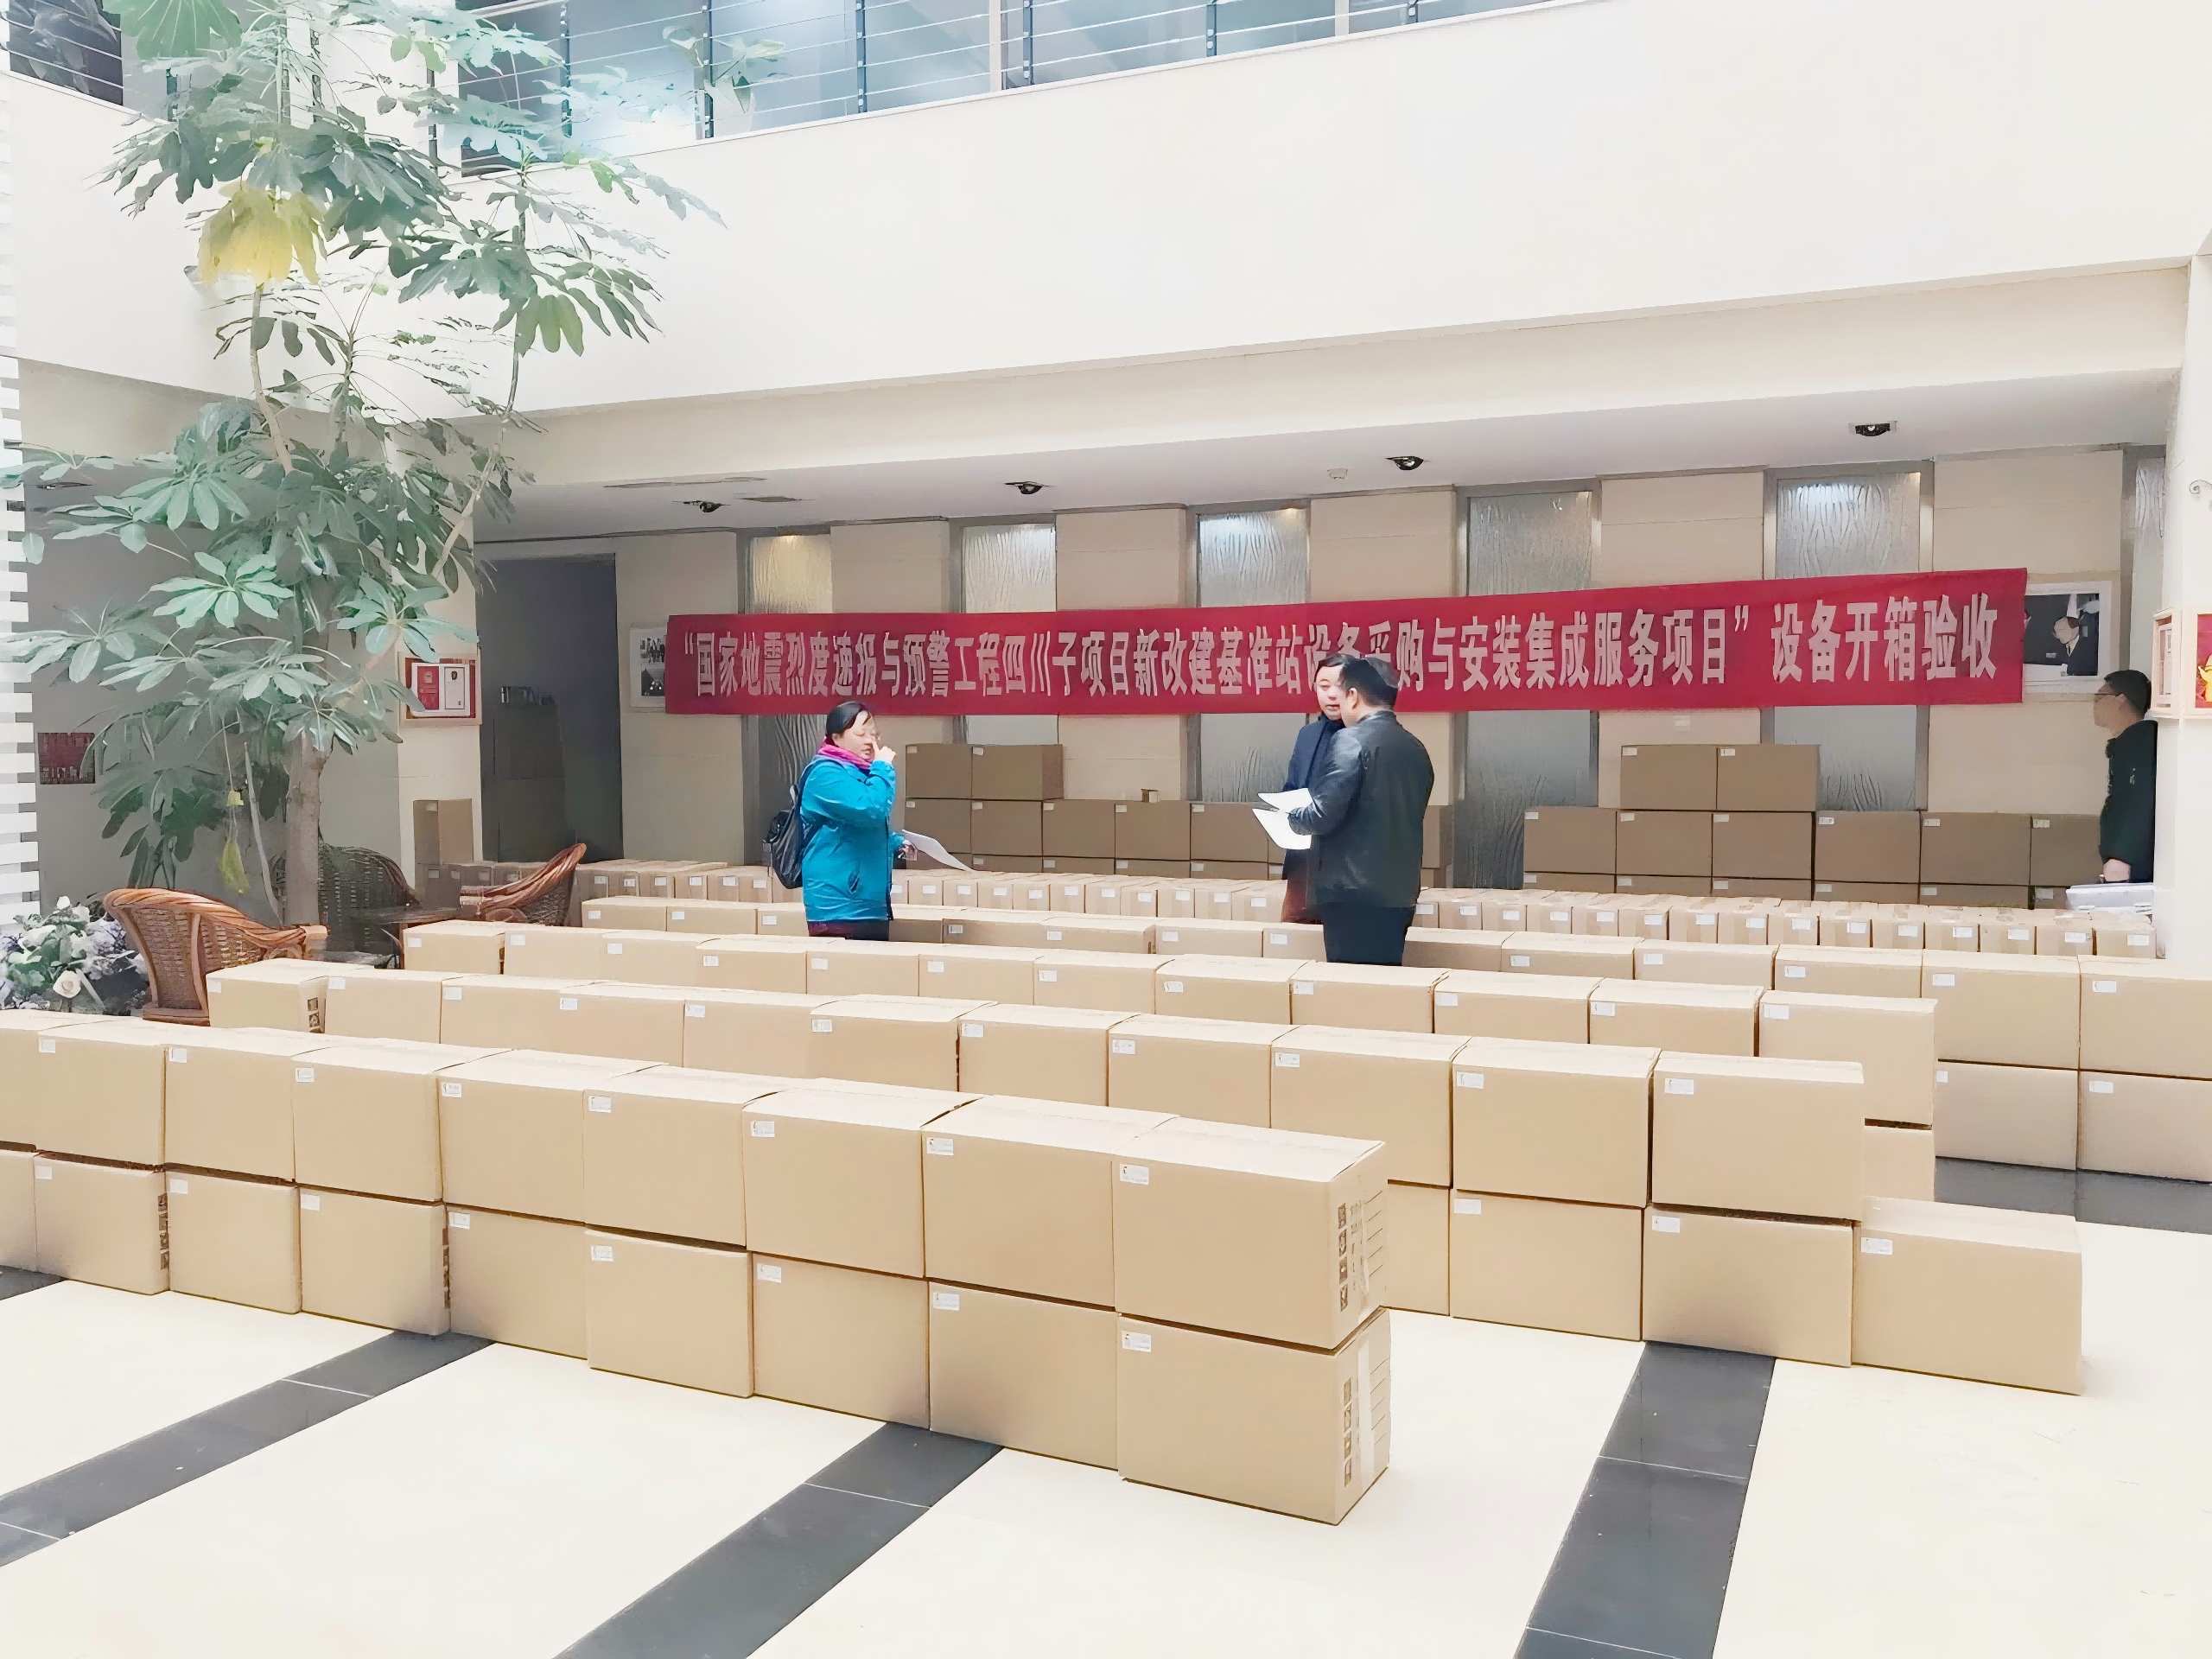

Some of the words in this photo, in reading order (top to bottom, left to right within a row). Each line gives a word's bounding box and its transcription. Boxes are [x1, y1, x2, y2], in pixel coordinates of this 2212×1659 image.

[1770, 592, 1998, 683] 设备开箱验收
